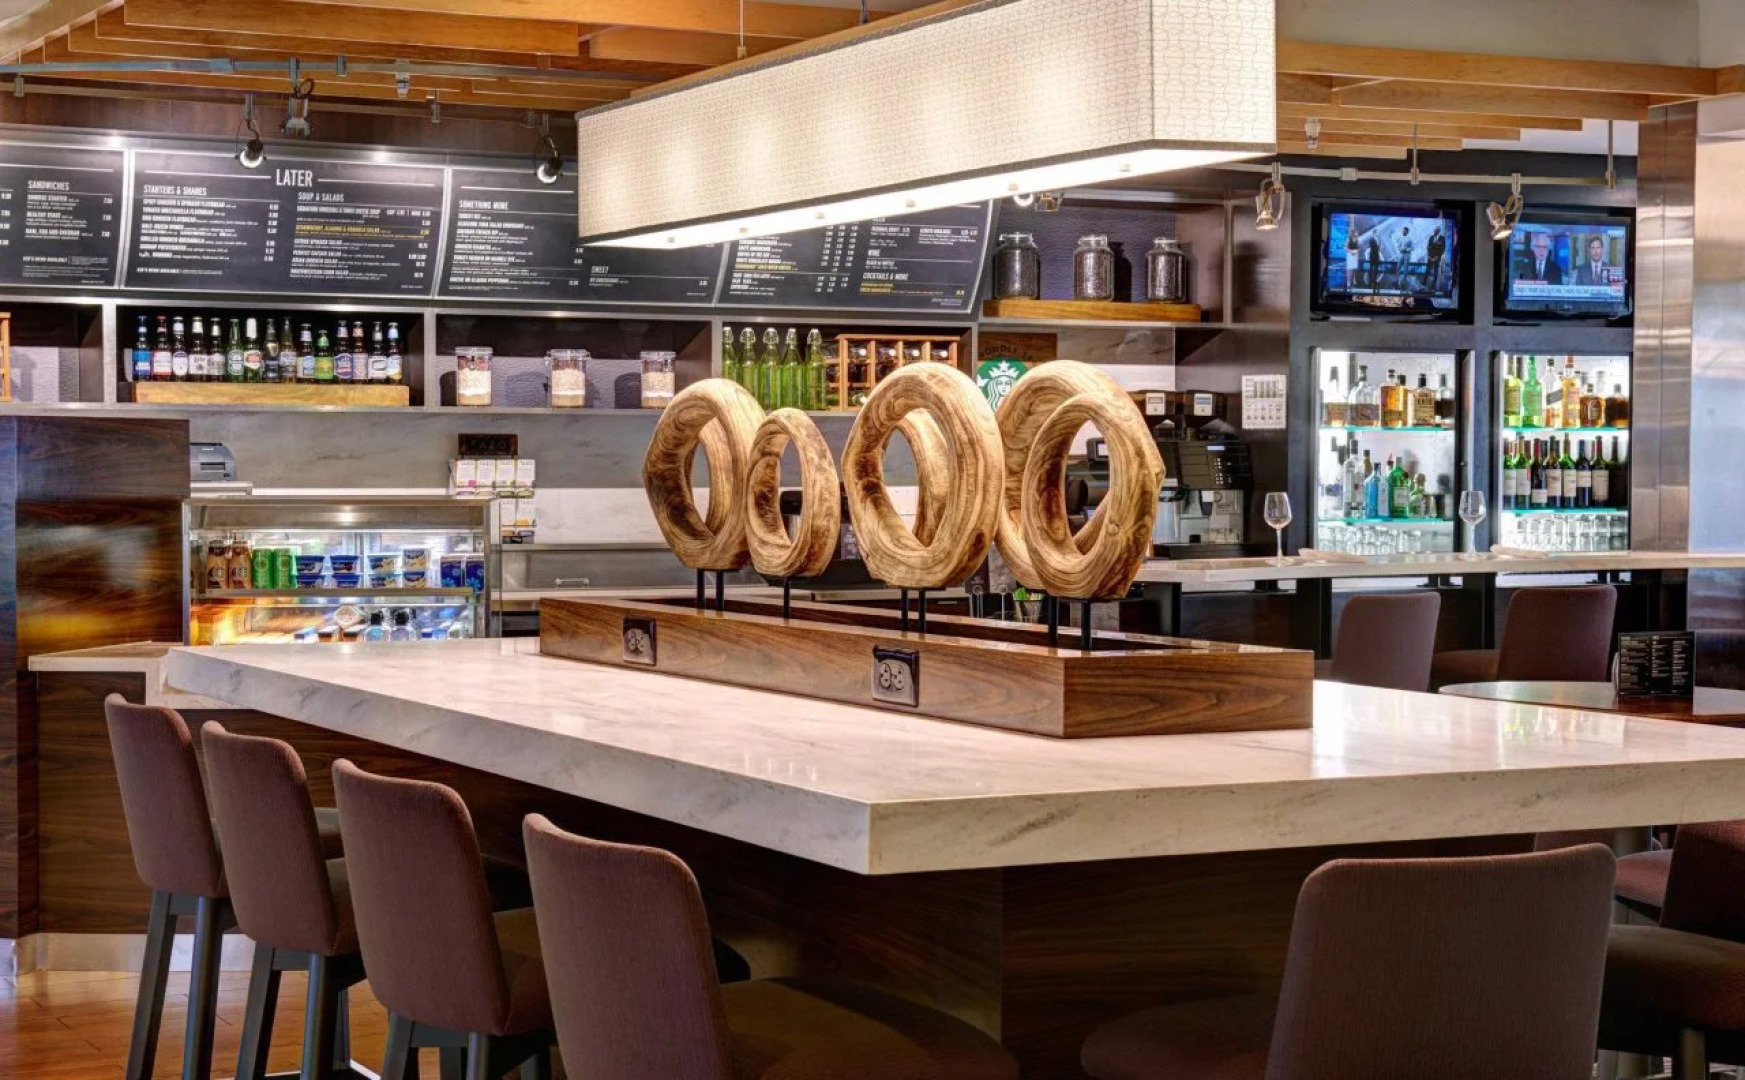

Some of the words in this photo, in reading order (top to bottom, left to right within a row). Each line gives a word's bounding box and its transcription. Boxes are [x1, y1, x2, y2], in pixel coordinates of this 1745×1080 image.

[276, 168, 313, 188] LATER
[27, 180, 70, 191] SANDWICHES
[143, 184, 175, 195] STARTERS
[183, 186, 207, 196] SHARES
[298, 192, 314, 201] SOUP
[322, 193, 345, 202] SALADS
[459, 200, 491, 210] SOMETHING
[493, 201, 508, 211] MORE
[867, 249, 881, 257] WINE
[591, 265, 609, 274] SWEET
[863, 272, 888, 281] COCKTAILS
[894, 273, 909, 281] MORE
